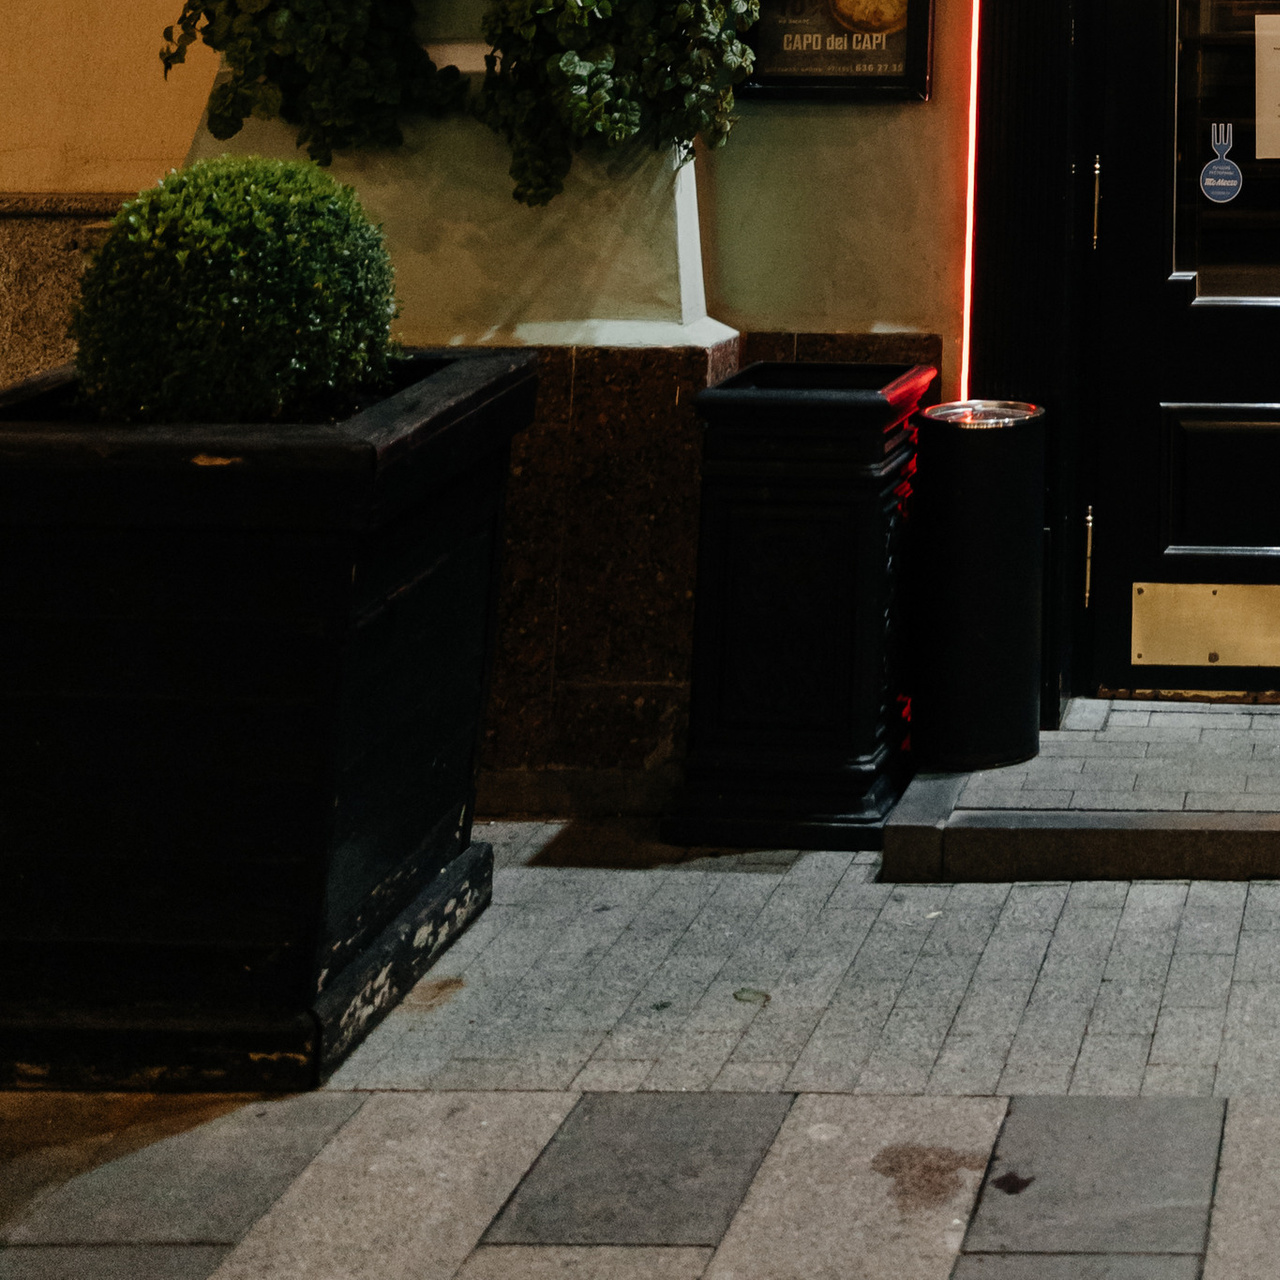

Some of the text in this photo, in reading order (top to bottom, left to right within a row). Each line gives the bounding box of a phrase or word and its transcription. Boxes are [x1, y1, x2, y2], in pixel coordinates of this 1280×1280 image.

[783, 32, 887, 51] CAPO dei CAPI
